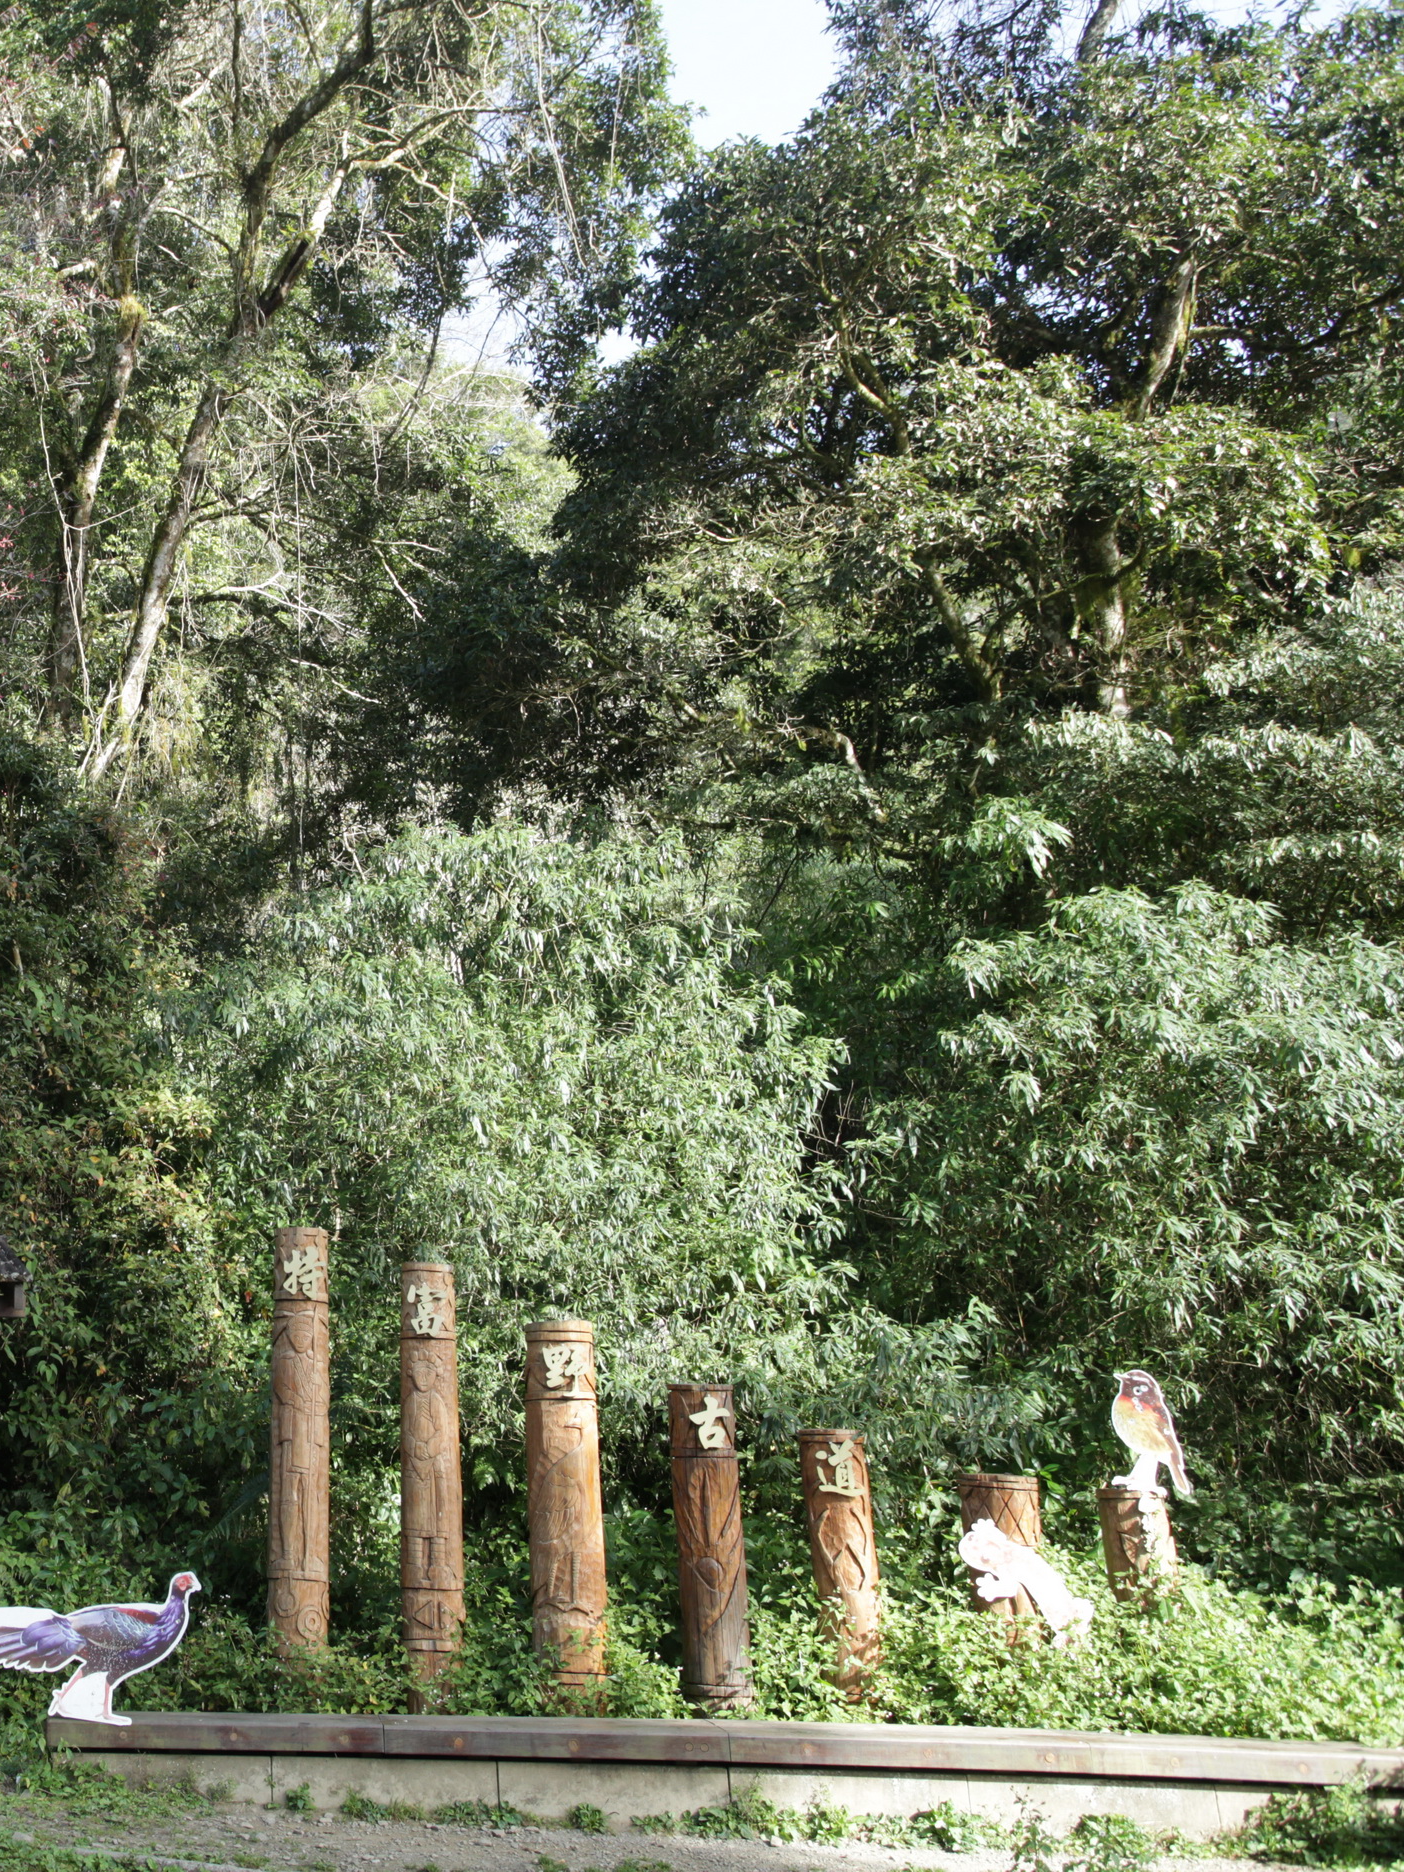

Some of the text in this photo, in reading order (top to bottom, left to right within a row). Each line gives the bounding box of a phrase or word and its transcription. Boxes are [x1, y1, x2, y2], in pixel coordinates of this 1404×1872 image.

[283, 1246, 866, 1497] 特 富 野 古 道
